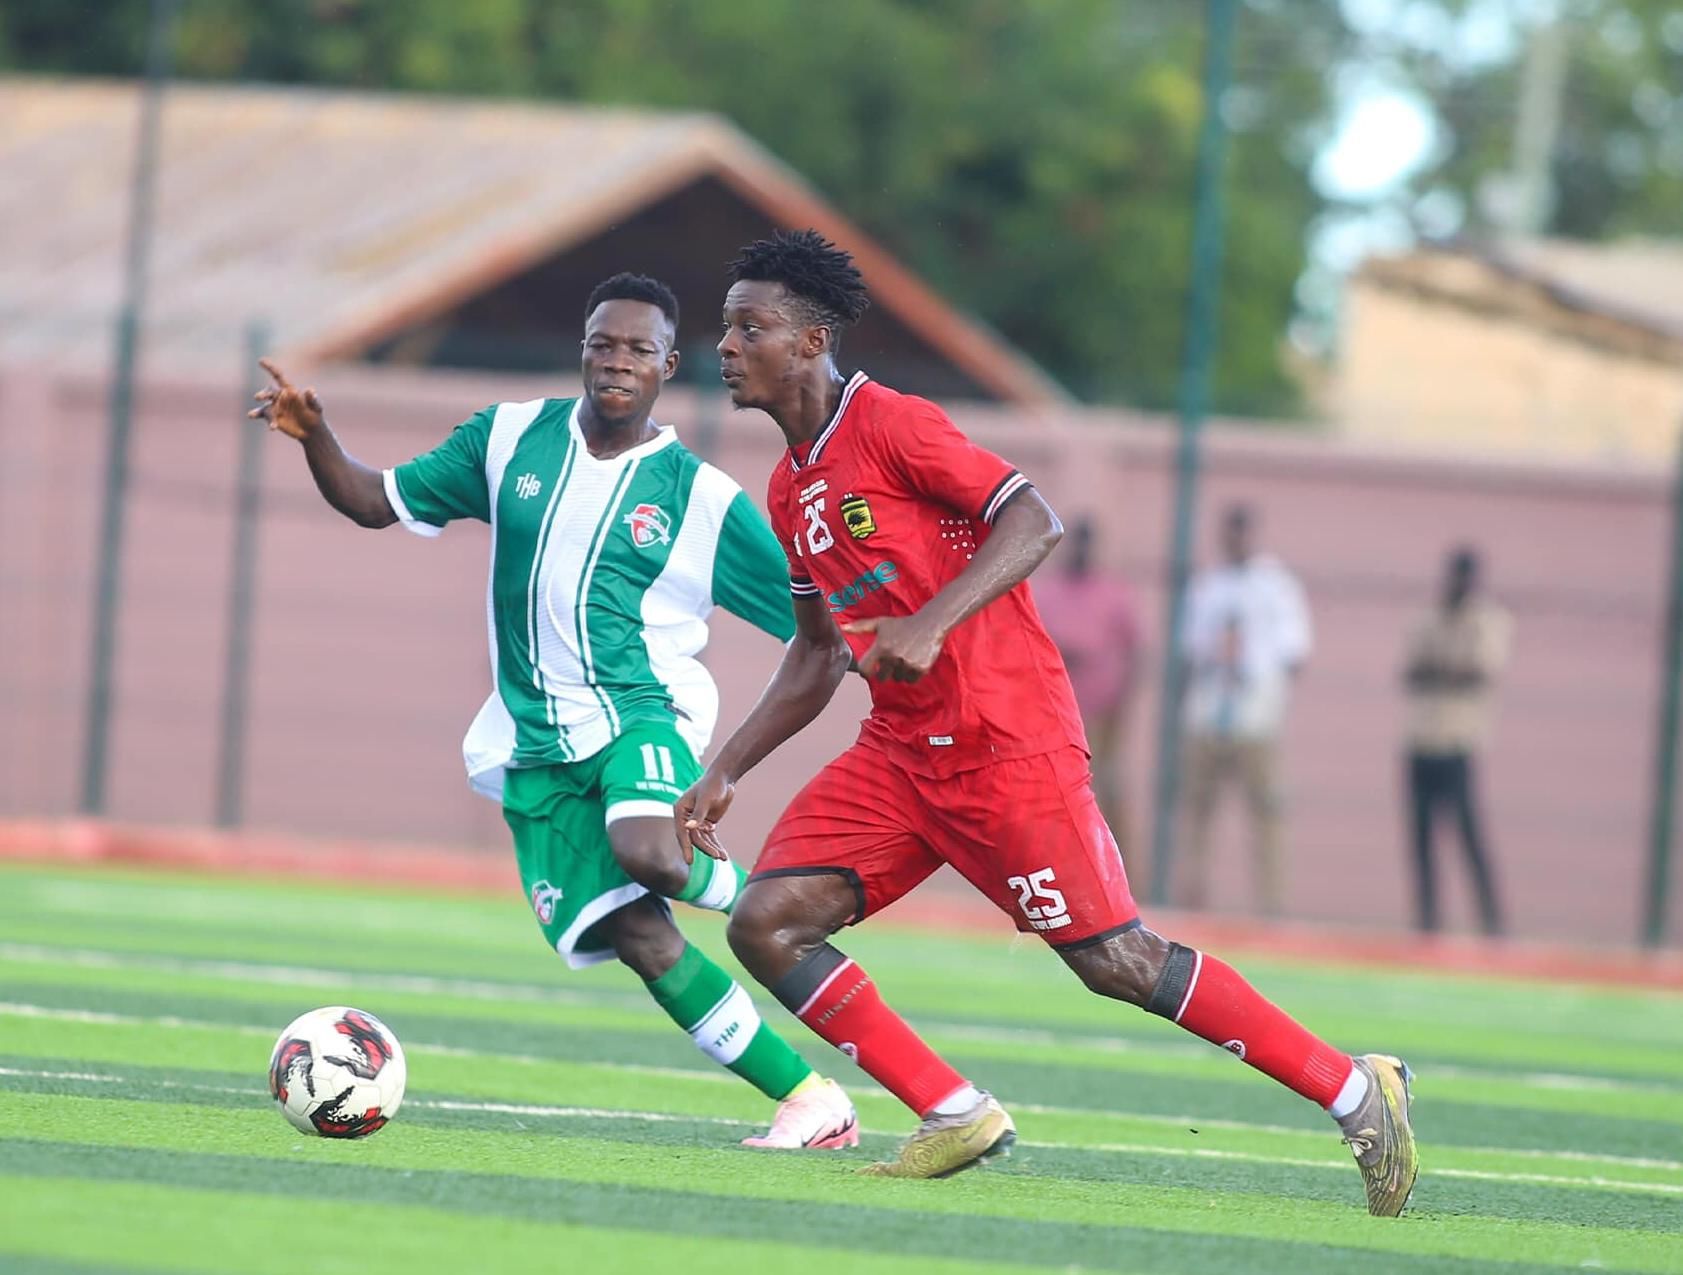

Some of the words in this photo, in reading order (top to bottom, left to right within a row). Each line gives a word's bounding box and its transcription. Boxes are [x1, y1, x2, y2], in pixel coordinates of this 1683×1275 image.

[515, 472, 542, 500] THB
[639, 743, 676, 785] 11
[1007, 867, 1068, 919] 25
